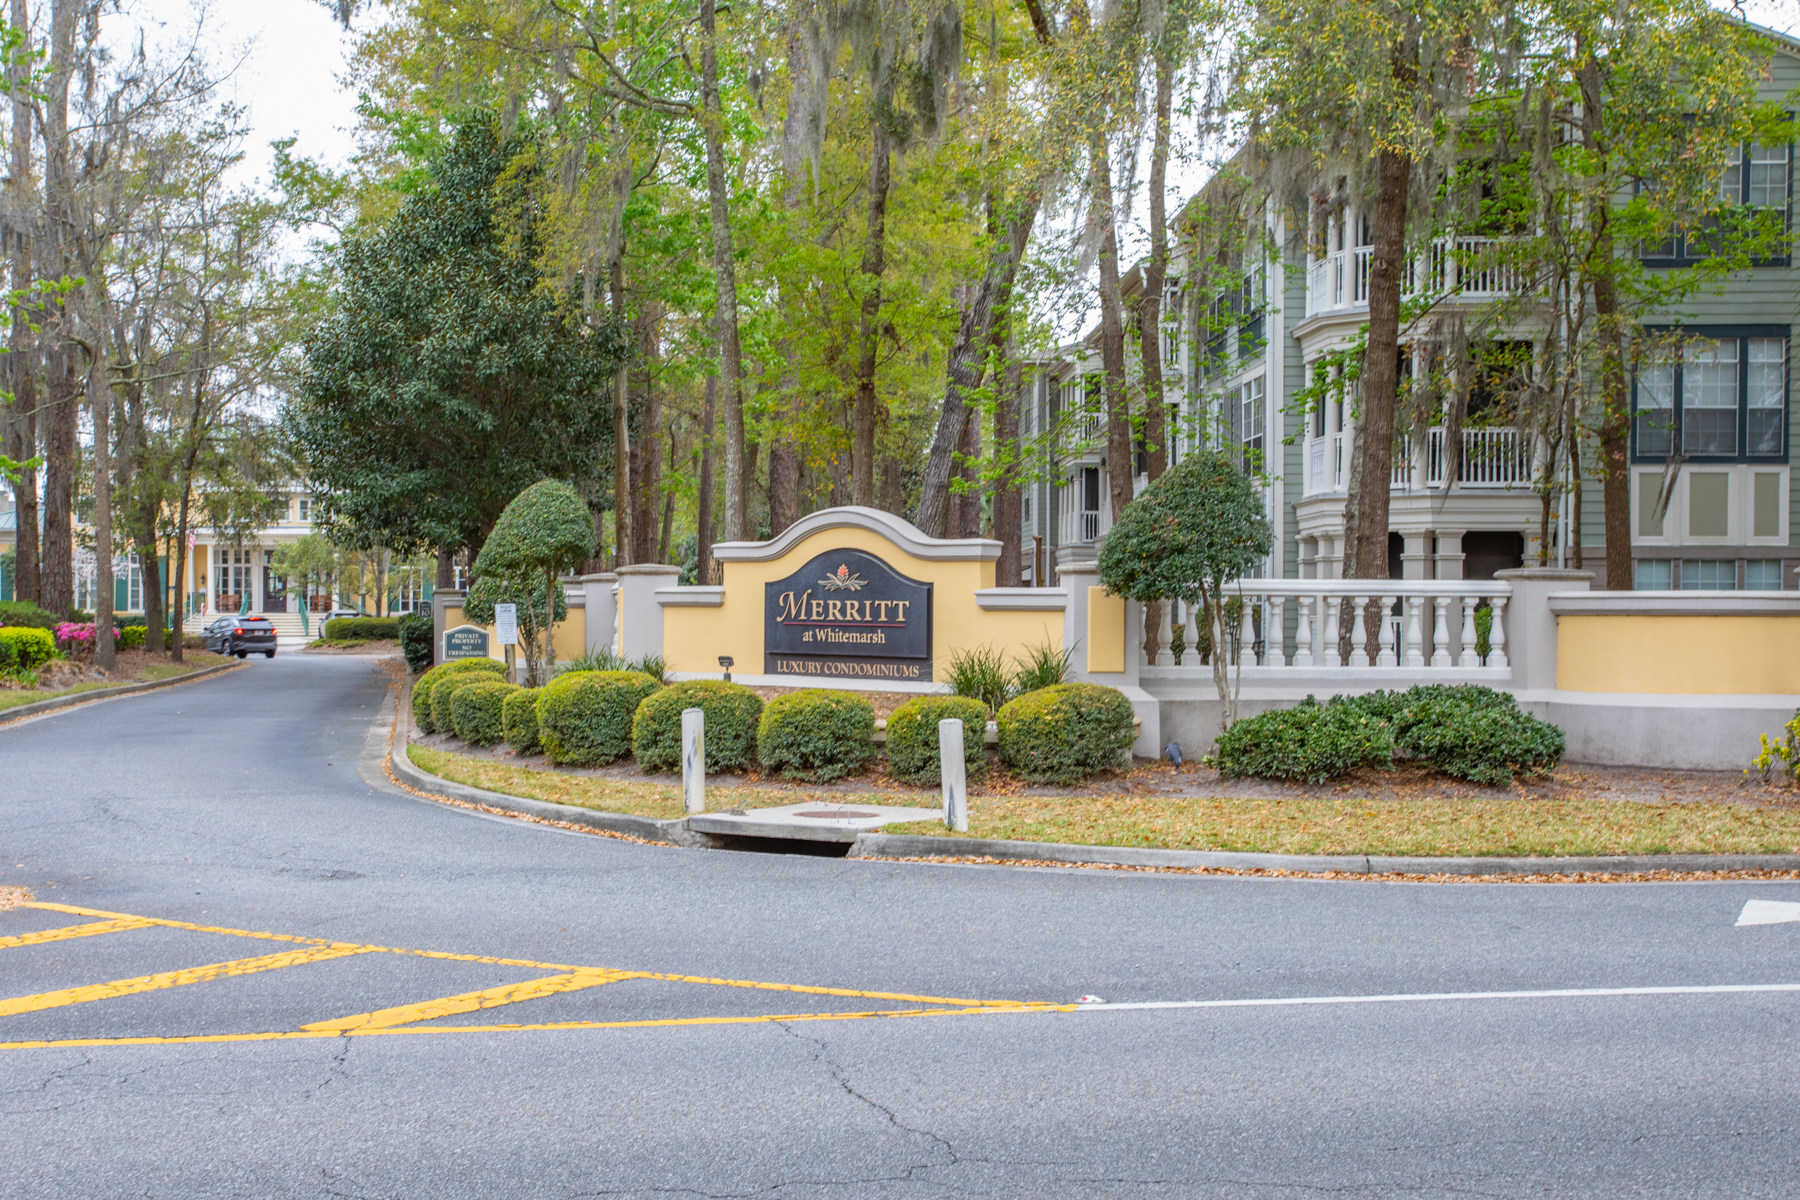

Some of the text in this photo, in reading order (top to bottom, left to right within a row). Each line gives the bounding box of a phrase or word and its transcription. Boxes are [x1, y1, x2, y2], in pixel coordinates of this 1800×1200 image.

[776, 588, 910, 622] MERRITT
[802, 628, 886, 644] at Whitemarsh
[777, 660, 920, 678] LUXURY CONDOMINIUMS
